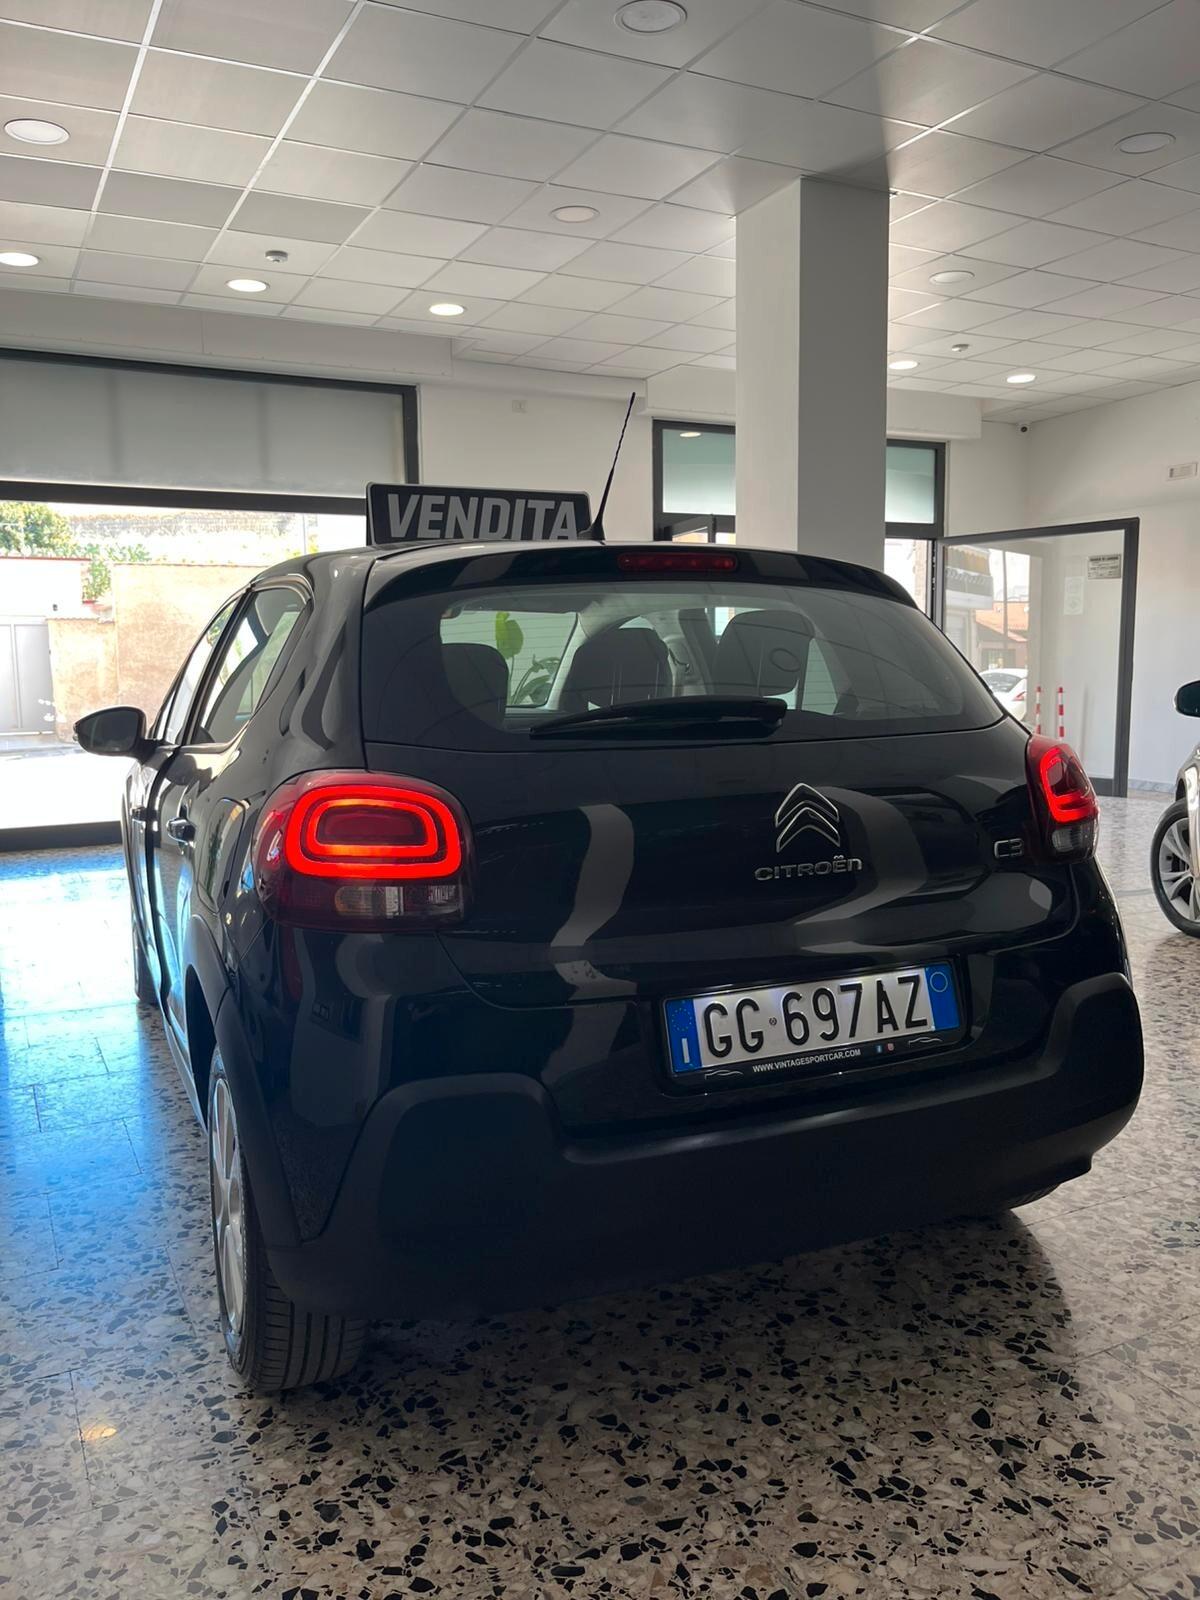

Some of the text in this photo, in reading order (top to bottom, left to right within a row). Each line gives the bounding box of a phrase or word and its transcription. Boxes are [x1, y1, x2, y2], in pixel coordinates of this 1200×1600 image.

[387, 493, 578, 541] VENDITA
[993, 838, 1024, 859] C3
[752, 1048, 861, 1073] WWW.VINTAGESPORTCAR.COM
